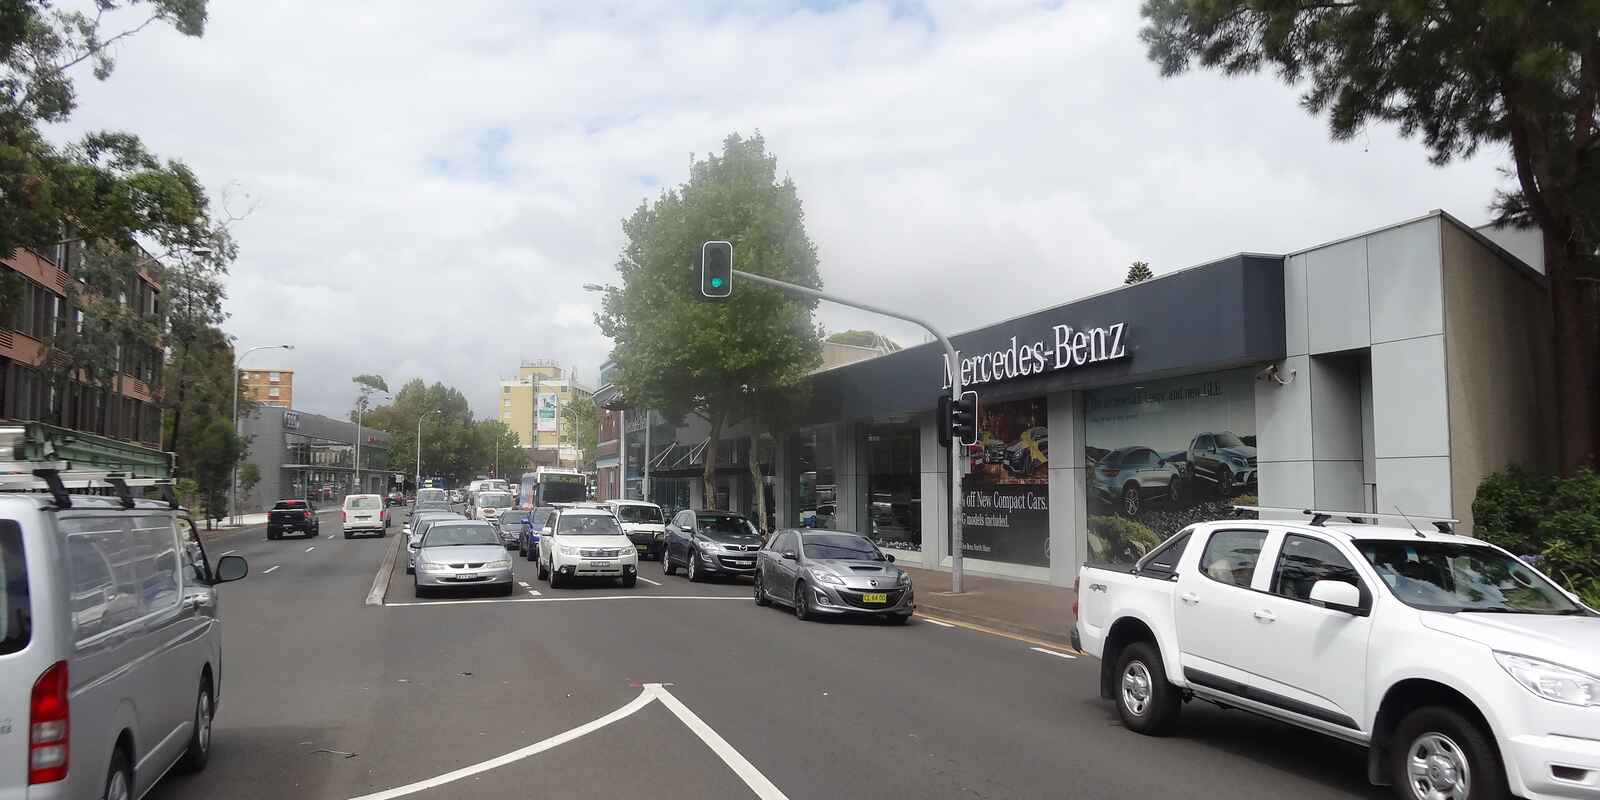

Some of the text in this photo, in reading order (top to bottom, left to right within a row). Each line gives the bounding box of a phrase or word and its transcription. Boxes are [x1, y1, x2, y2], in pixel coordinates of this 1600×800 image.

[942, 322, 1125, 389] Mercedes-Benz
[966, 491, 976, 508] off
[977, 491, 992, 508] New
[993, 491, 1026, 513] Compact
[1027, 491, 1048, 510] Cars.
